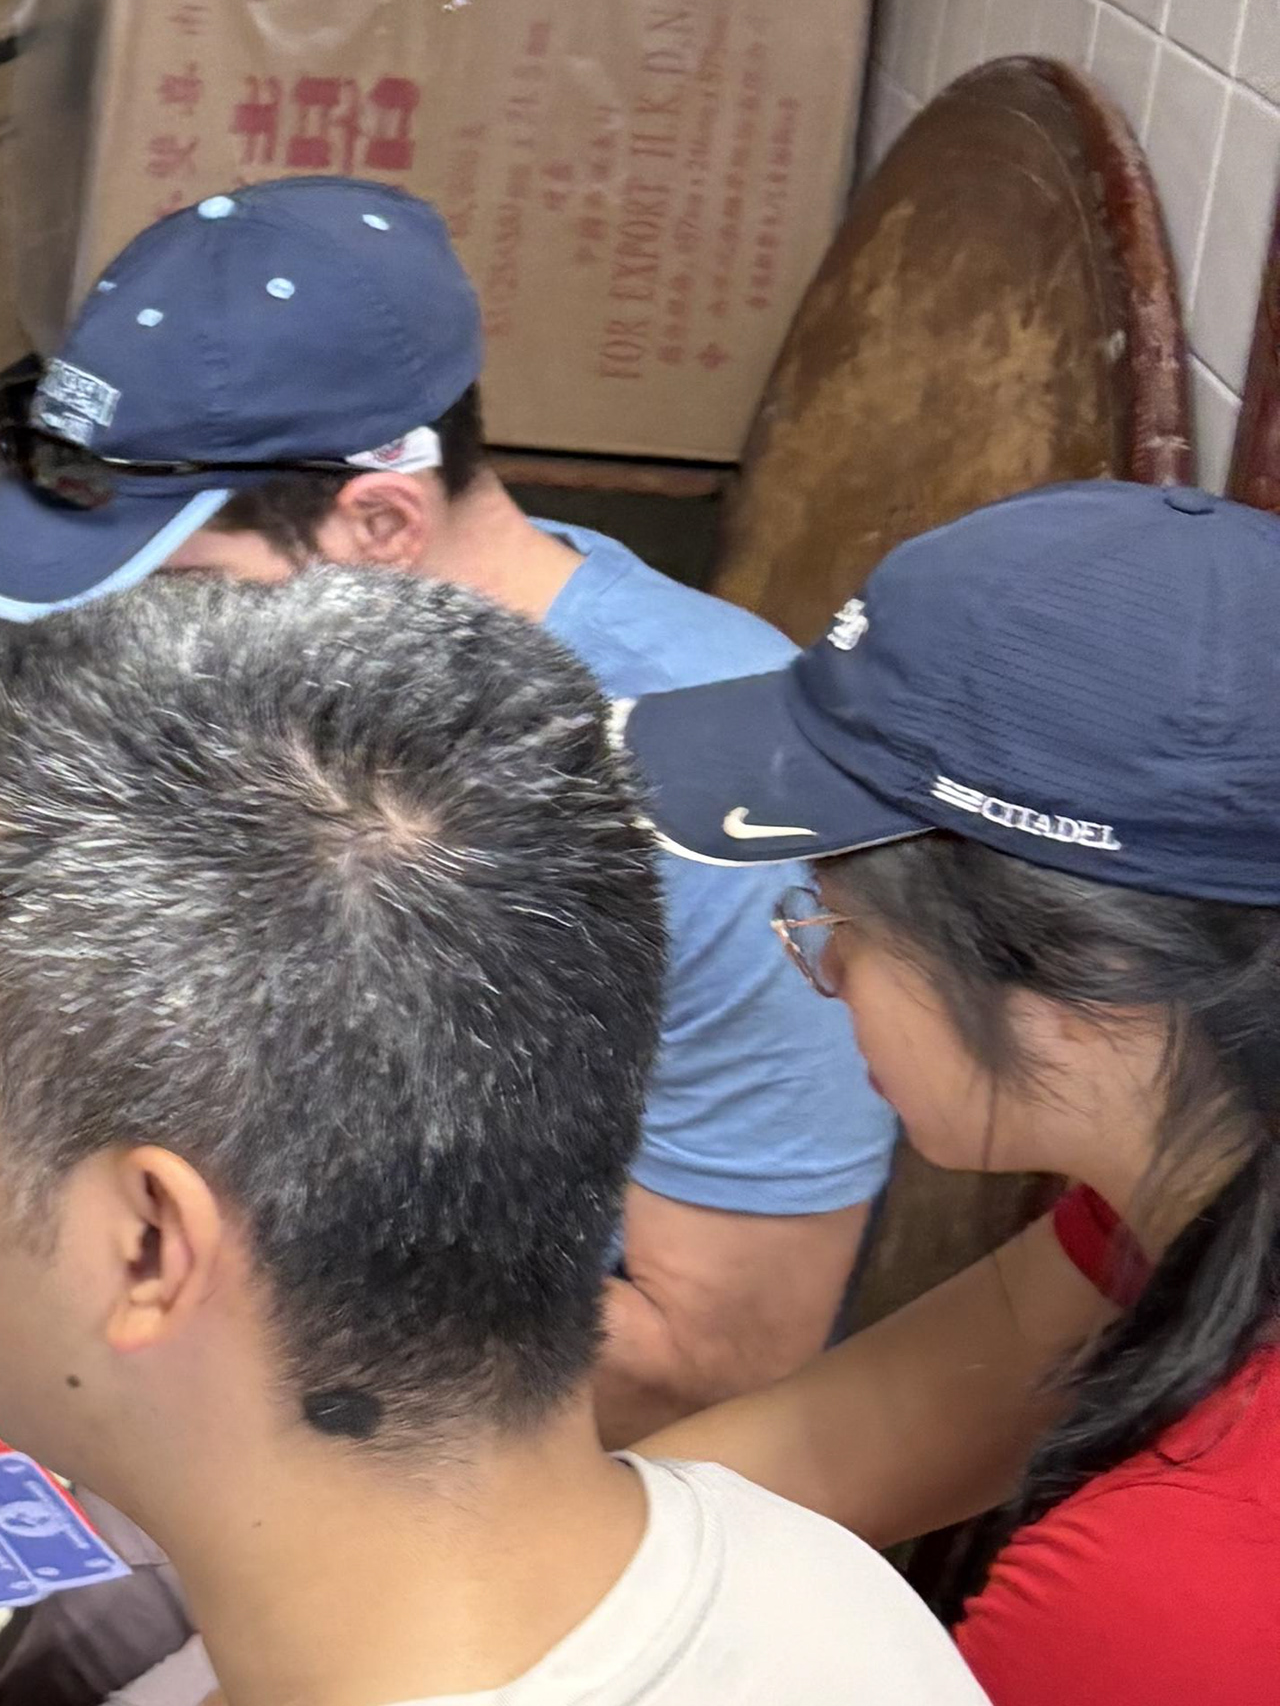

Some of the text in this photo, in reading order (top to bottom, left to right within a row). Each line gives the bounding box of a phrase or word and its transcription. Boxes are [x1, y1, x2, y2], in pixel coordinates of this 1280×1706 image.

[607, 177, 671, 302] EXPORT
[592, 319, 651, 381] FOR
[980, 796, 1124, 851] CITADEL
